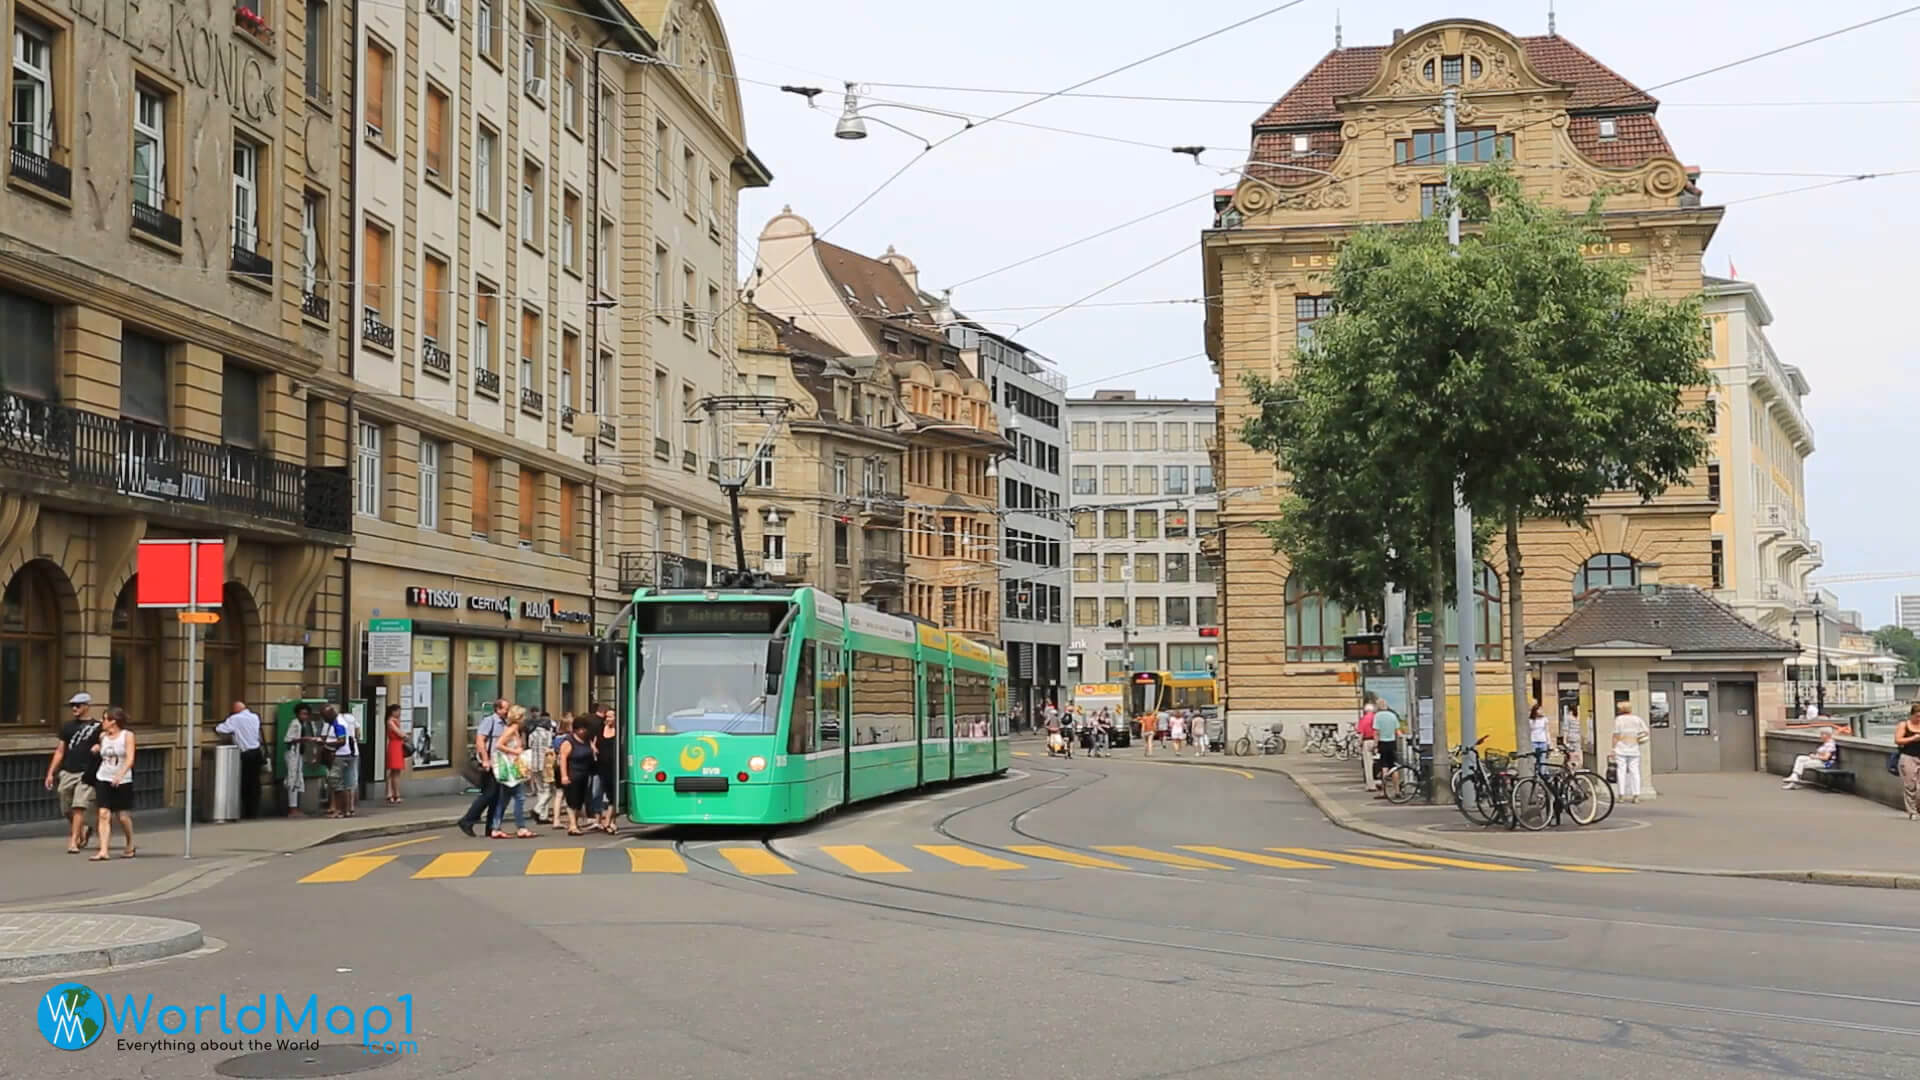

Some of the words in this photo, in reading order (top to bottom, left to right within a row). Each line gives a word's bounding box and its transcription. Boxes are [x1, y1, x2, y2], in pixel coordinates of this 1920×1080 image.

[427, 589, 462, 609] TISSOT
[471, 596, 509, 612] CERTINA
[525, 602, 550, 618] RADO
